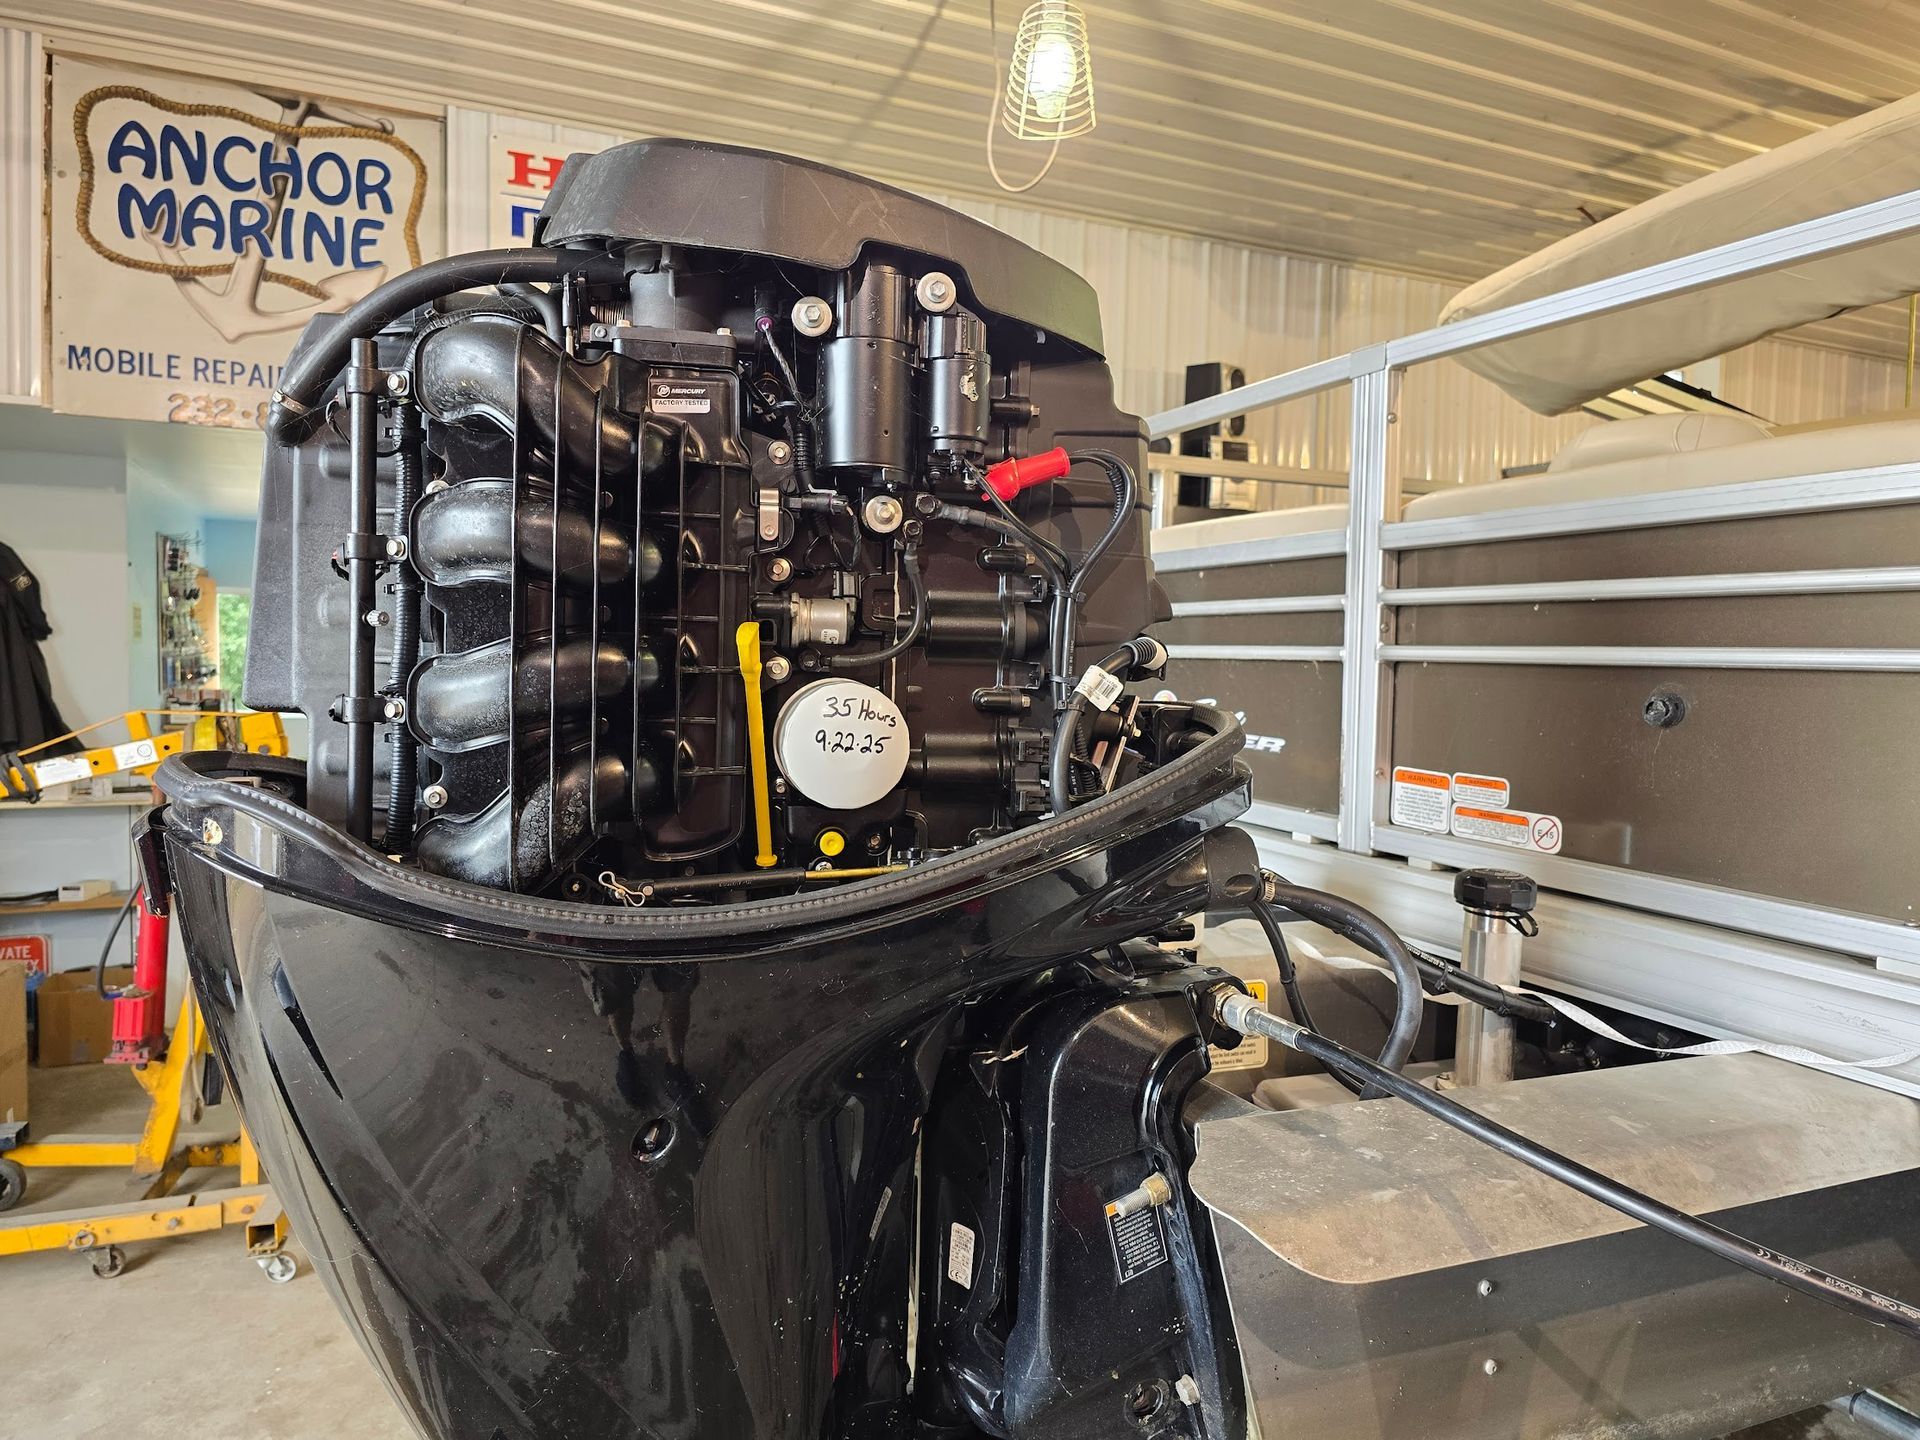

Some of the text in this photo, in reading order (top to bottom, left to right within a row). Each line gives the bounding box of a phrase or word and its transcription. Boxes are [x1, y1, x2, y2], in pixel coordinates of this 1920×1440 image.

[107, 120, 393, 215] ANCHOR
[118, 182, 385, 269] MARINE
[67, 344, 286, 389] MOBILE REPAI
[823, 697, 897, 728] 35 Hours
[1407, 775, 1437, 785] WARNING
[1870, 1294, 1898, 1311] Cable
